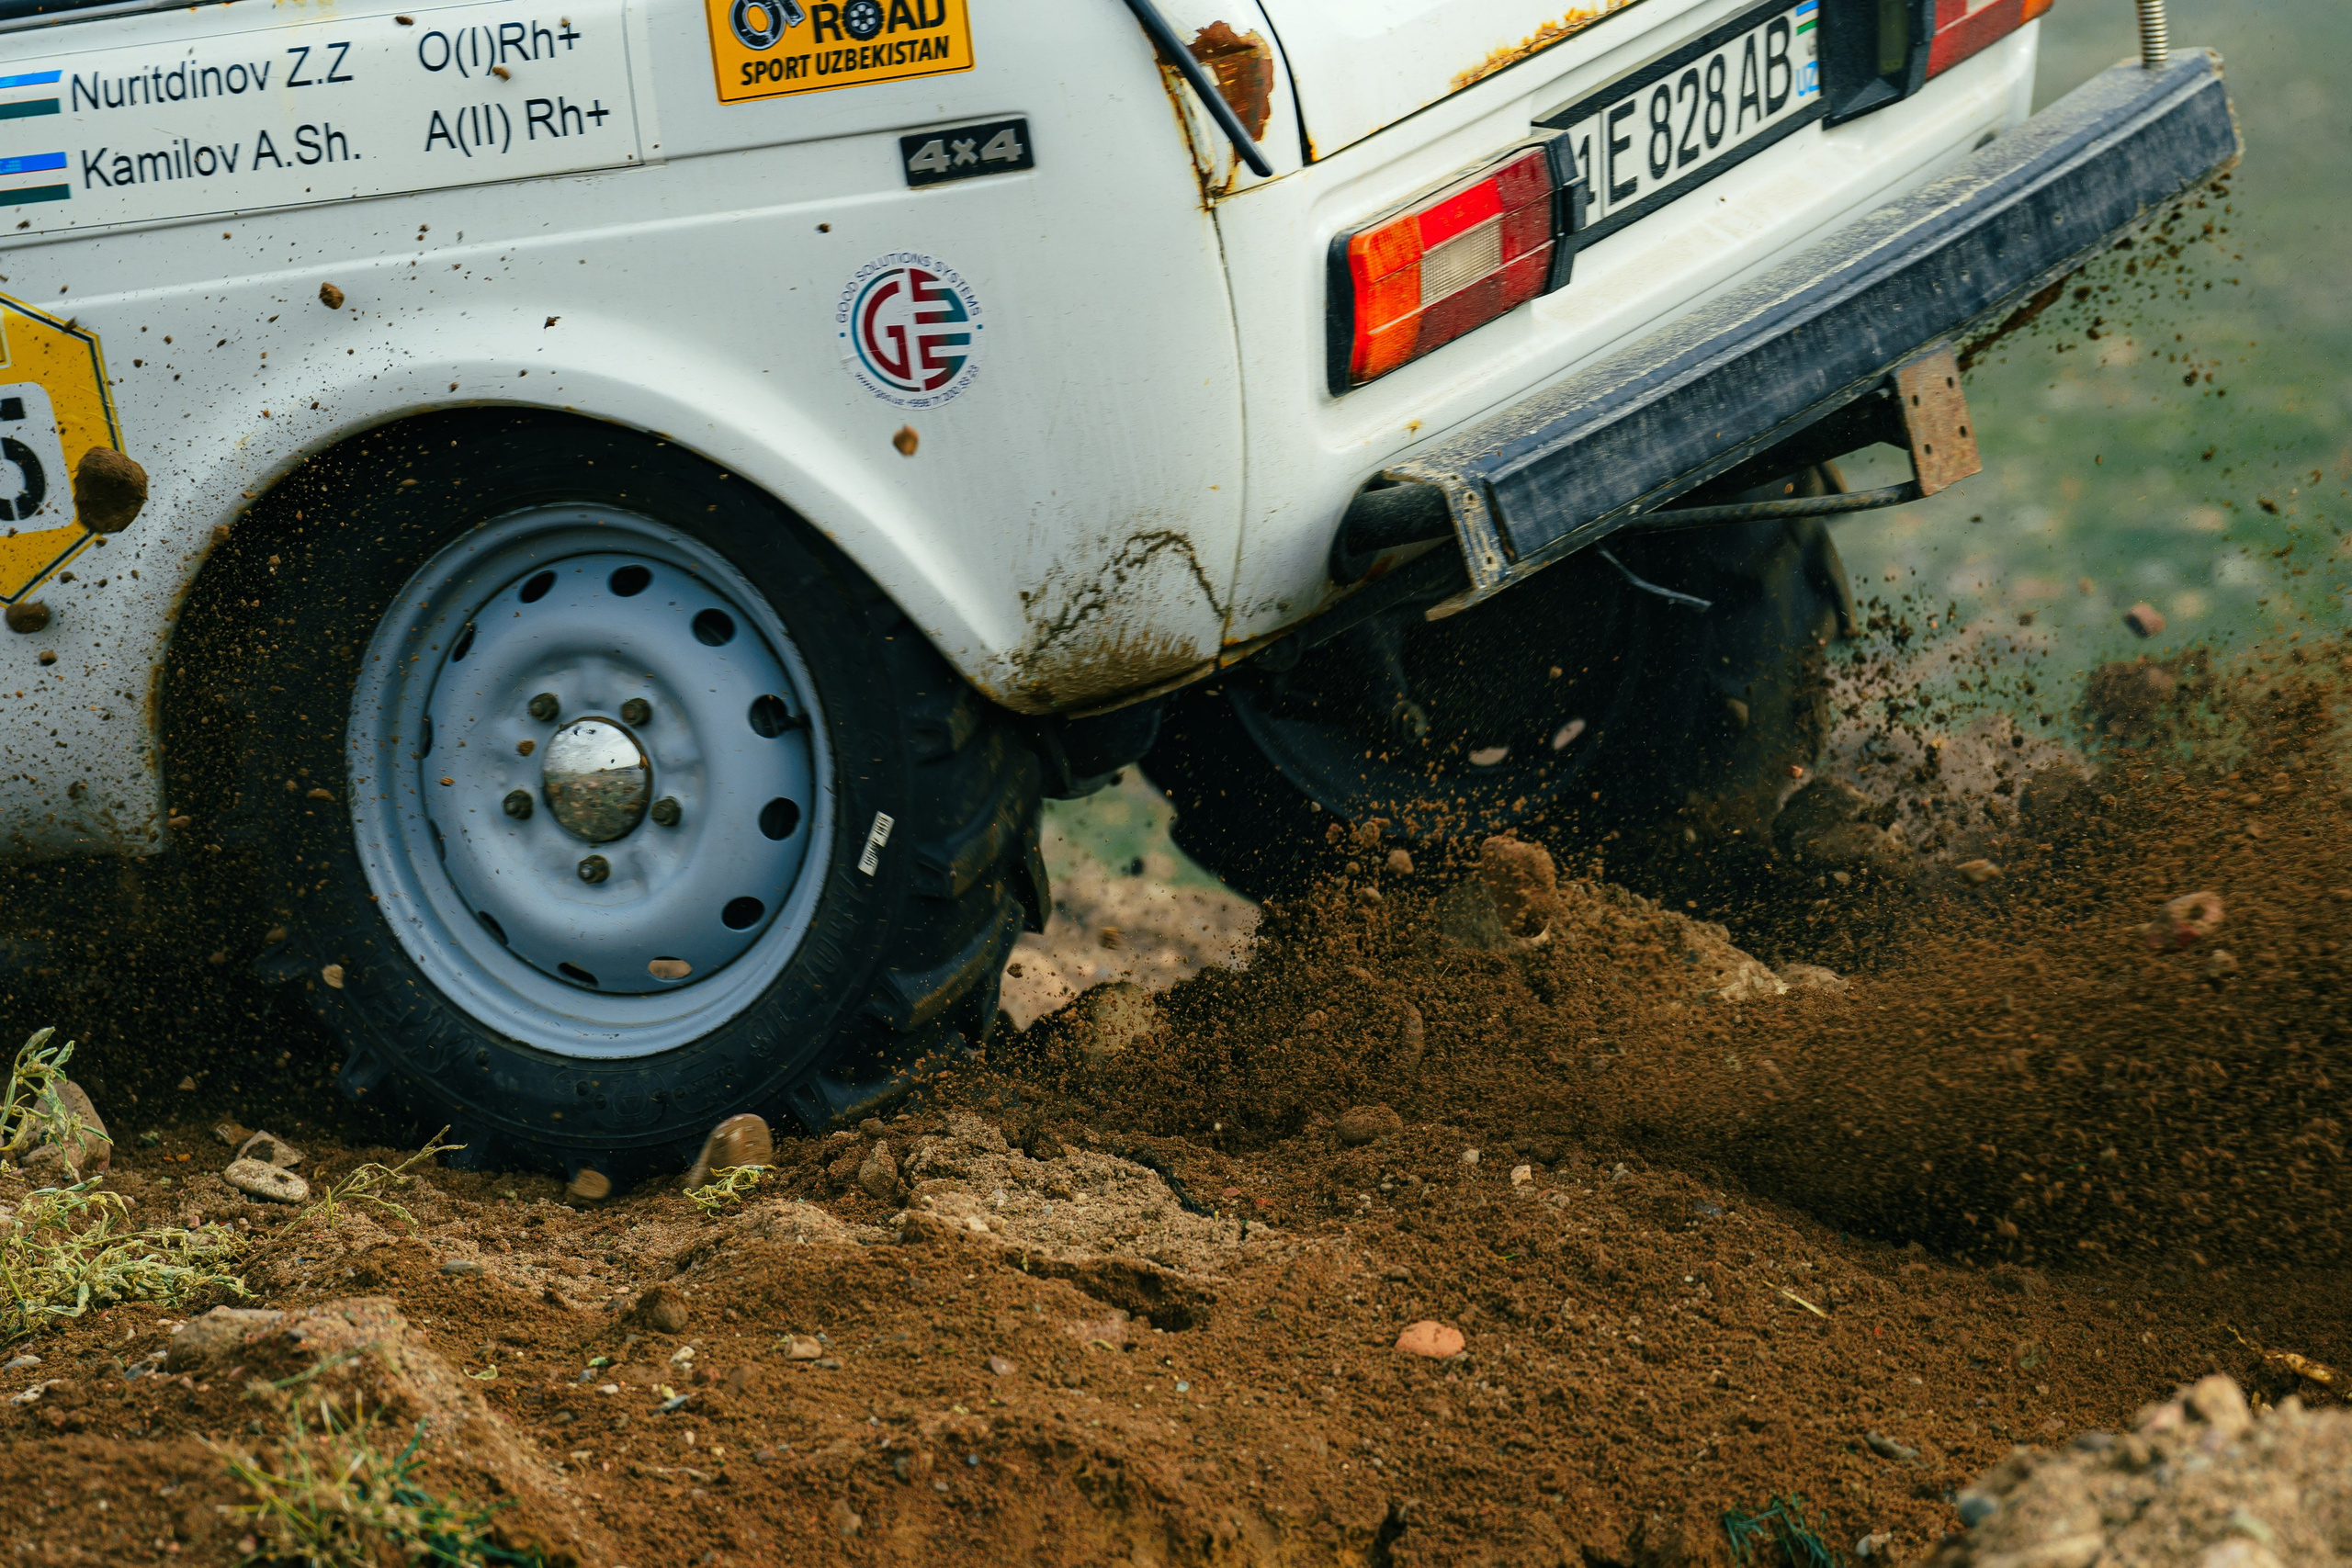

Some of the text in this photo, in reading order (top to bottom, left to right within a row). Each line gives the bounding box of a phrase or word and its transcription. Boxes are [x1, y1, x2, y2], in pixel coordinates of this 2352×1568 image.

[72, 61, 271, 112] Nuritdinov
[286, 42, 354, 88] Z.Z
[741, 35, 950, 85] SPORT UZBEKISTAN
[1649, 54, 1726, 180] 828
[1737, 16, 1792, 134] AB
[82, 96, 610, 189] Kamilov A.Sh. A(II) Rh+
[908, 128, 1024, 174] 4x4
[834, 252, 984, 324] GOOD SOLUTIONS SYSTEMS
